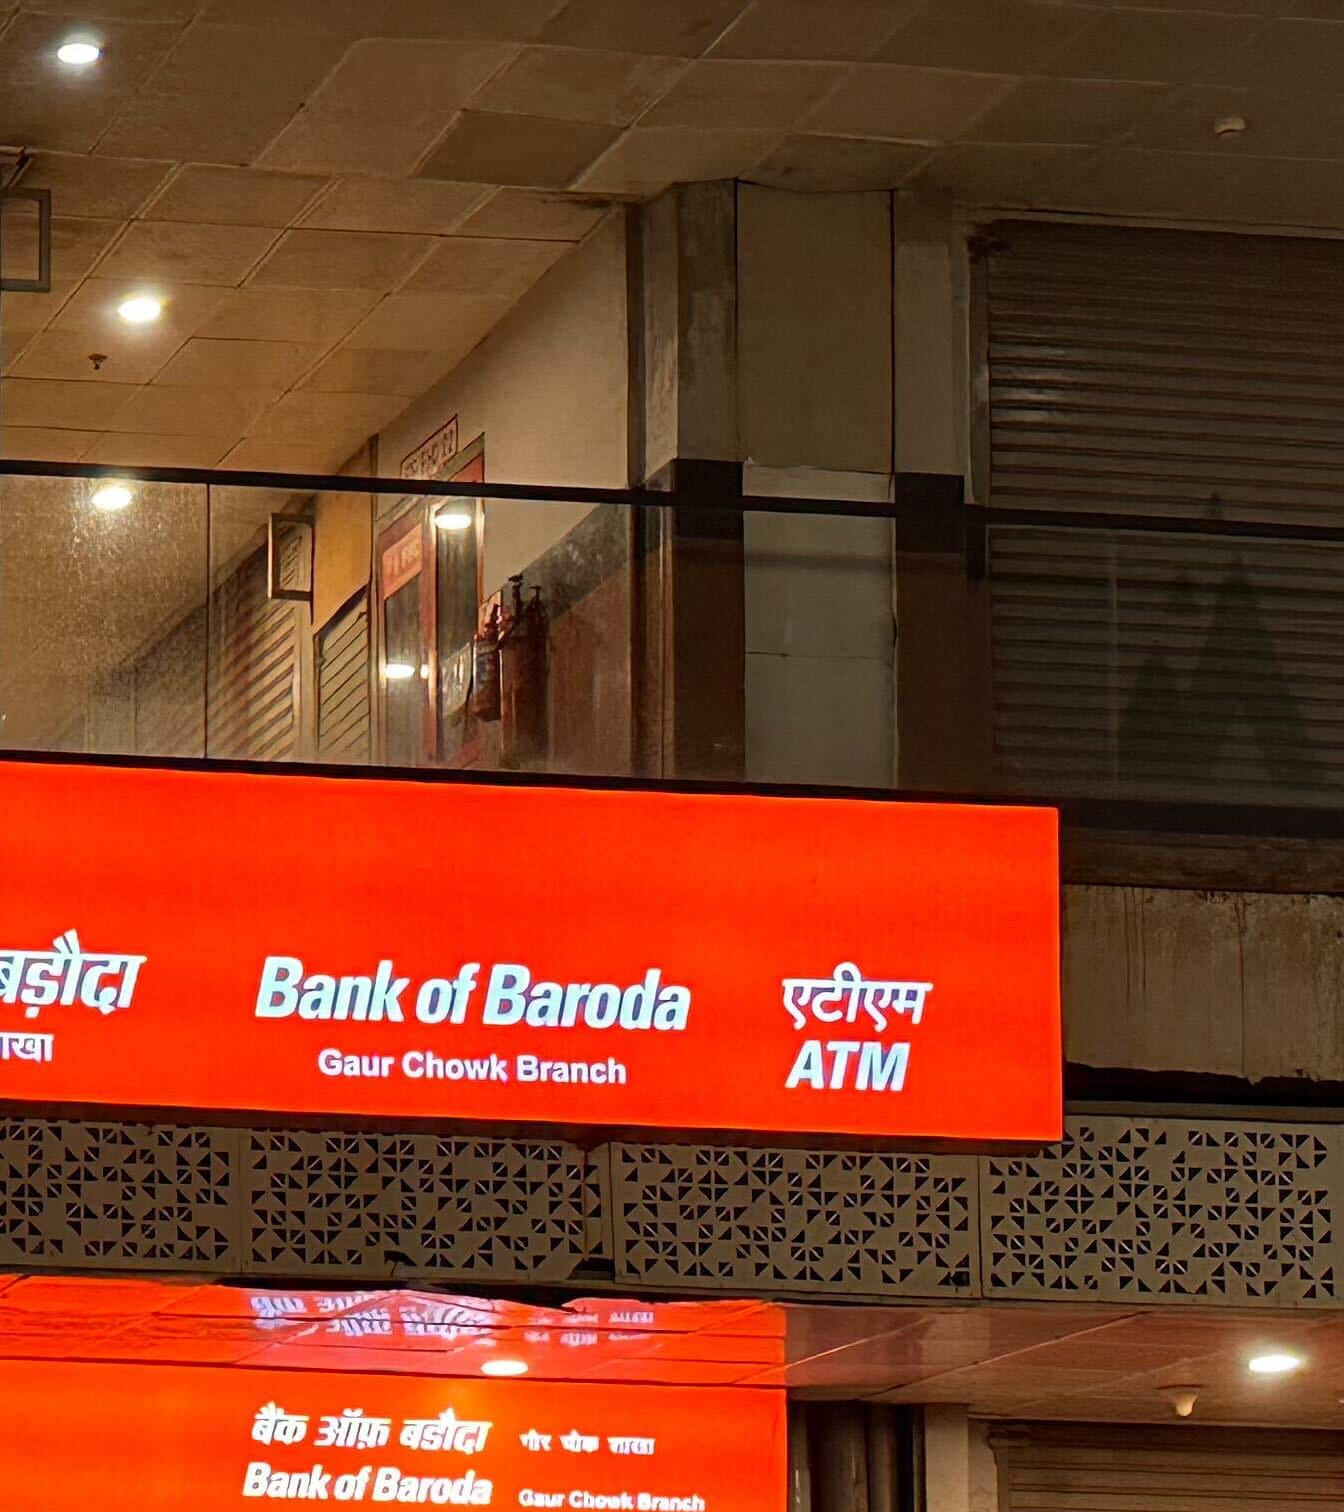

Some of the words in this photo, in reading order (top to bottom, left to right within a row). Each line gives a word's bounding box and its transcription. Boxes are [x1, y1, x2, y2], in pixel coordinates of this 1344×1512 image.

[255, 956, 409, 1021] Bank
[416, 963, 480, 1025] of
[482, 964, 691, 1031] Baroda
[782, 962, 934, 1031] एटीएम
[318, 1049, 394, 1078] Gaur
[402, 1051, 508, 1082] Chowk
[516, 1055, 627, 1084] Branch
[785, 1040, 910, 1092] ATM
[251, 1400, 309, 1446] बैंक
[242, 1462, 331, 1500] Bank
[334, 1466, 372, 1501] of
[372, 1467, 493, 1505] Baroda
[518, 1488, 566, 1508] Gaur
[568, 1489, 634, 1511] Chowk
[636, 1492, 706, 1512] Branch
